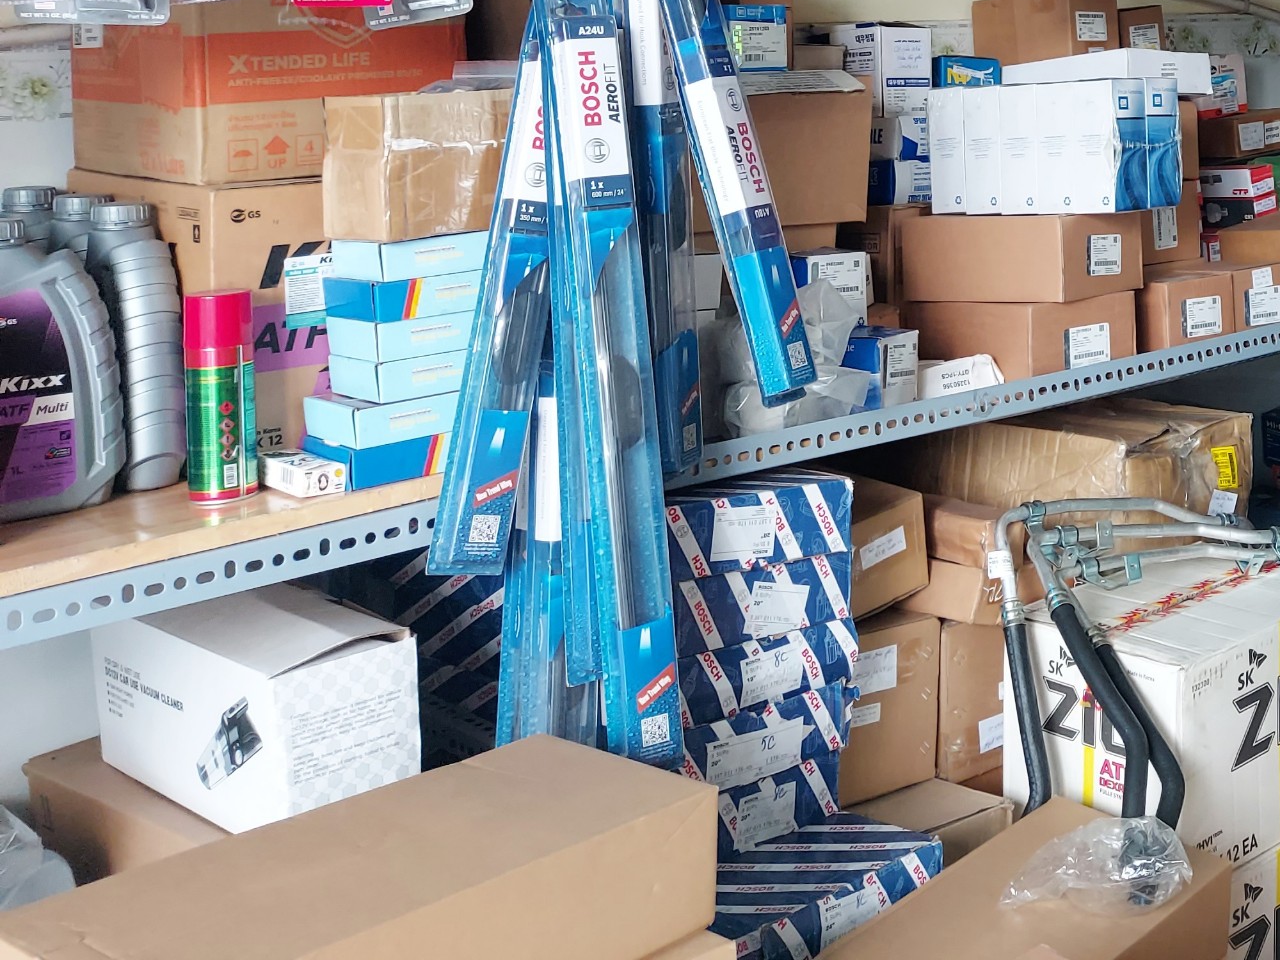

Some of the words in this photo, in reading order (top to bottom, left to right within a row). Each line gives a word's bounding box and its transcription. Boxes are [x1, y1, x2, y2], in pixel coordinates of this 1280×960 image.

[578, 25, 605, 36] A24U
[228, 54, 327, 75] XTENDED
[332, 52, 370, 68] LIFE
[577, 50, 603, 127] BOSCH
[603, 63, 621, 124] AEROFIT
[304, 141, 313, 153] 4
[726, 126, 750, 183] AEROFIT
[737, 122, 766, 194] BOSCH
[268, 159, 287, 170] UP
[247, 208, 261, 220] GS
[754, 208, 771, 219] A18U
[255, 321, 327, 354] ATF
[0, 373, 67, 394] Kixx
[36, 401, 70, 416] Multi
[266, 435, 283, 447] 12
[816, 502, 834, 537] BOSCH
[694, 601, 714, 636] BOSCH
[802, 647, 820, 680] BOSCH
[1047, 659, 1064, 678] SK
[1237, 666, 1255, 691] SK
[1241, 833, 1259, 856] EA
[1232, 902, 1250, 928] SK
